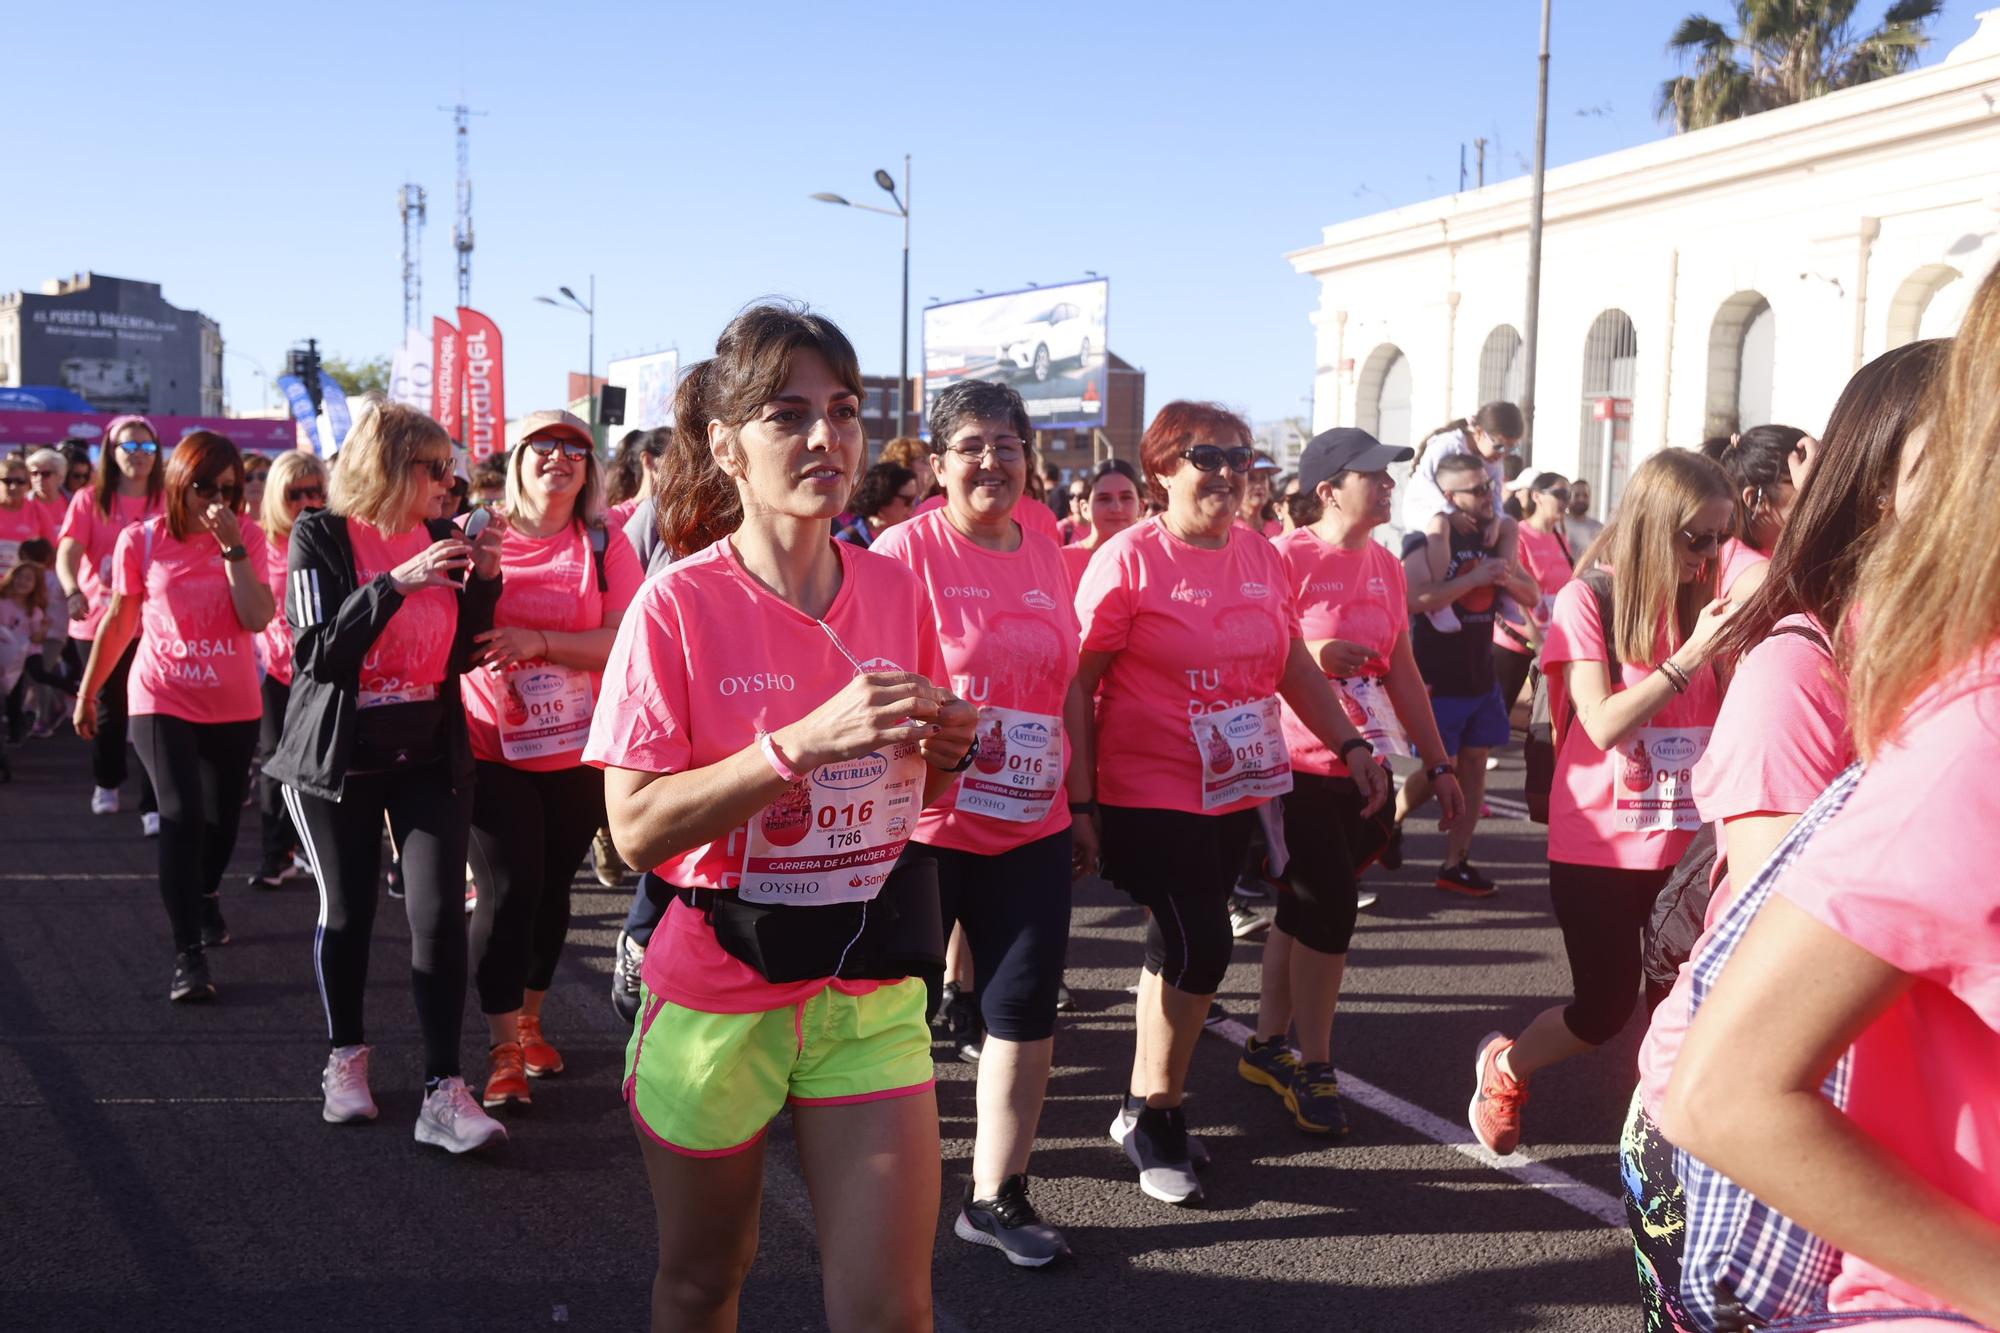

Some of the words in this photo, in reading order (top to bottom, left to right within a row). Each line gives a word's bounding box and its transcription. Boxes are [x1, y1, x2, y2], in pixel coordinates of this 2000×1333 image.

[467, 329, 496, 460] antander
[944, 586, 990, 598] OYSHO
[160, 639, 236, 658] DORSAL
[720, 673, 795, 695] OYSHO
[952, 673, 989, 701] TU
[1185, 668, 1219, 691] TU
[531, 699, 564, 715] 016
[893, 747, 917, 760] SUMA
[1236, 742, 1263, 760] 016
[819, 765, 882, 781] ASTURIANA
[1009, 755, 1042, 773] 016
[1012, 774, 1035, 785] 6211
[1656, 768, 1690, 783] 016
[975, 782, 1007, 794] CARRERA
[968, 795, 1005, 810] OYSHO
[818, 800, 874, 828] 016
[828, 830, 861, 848] 1786
[769, 861, 821, 870] CARRERA
[824, 859, 838, 867] DE
[840, 856, 852, 865] LA
[854, 850, 886, 862] MUJER
[760, 881, 819, 894] OYSHO
